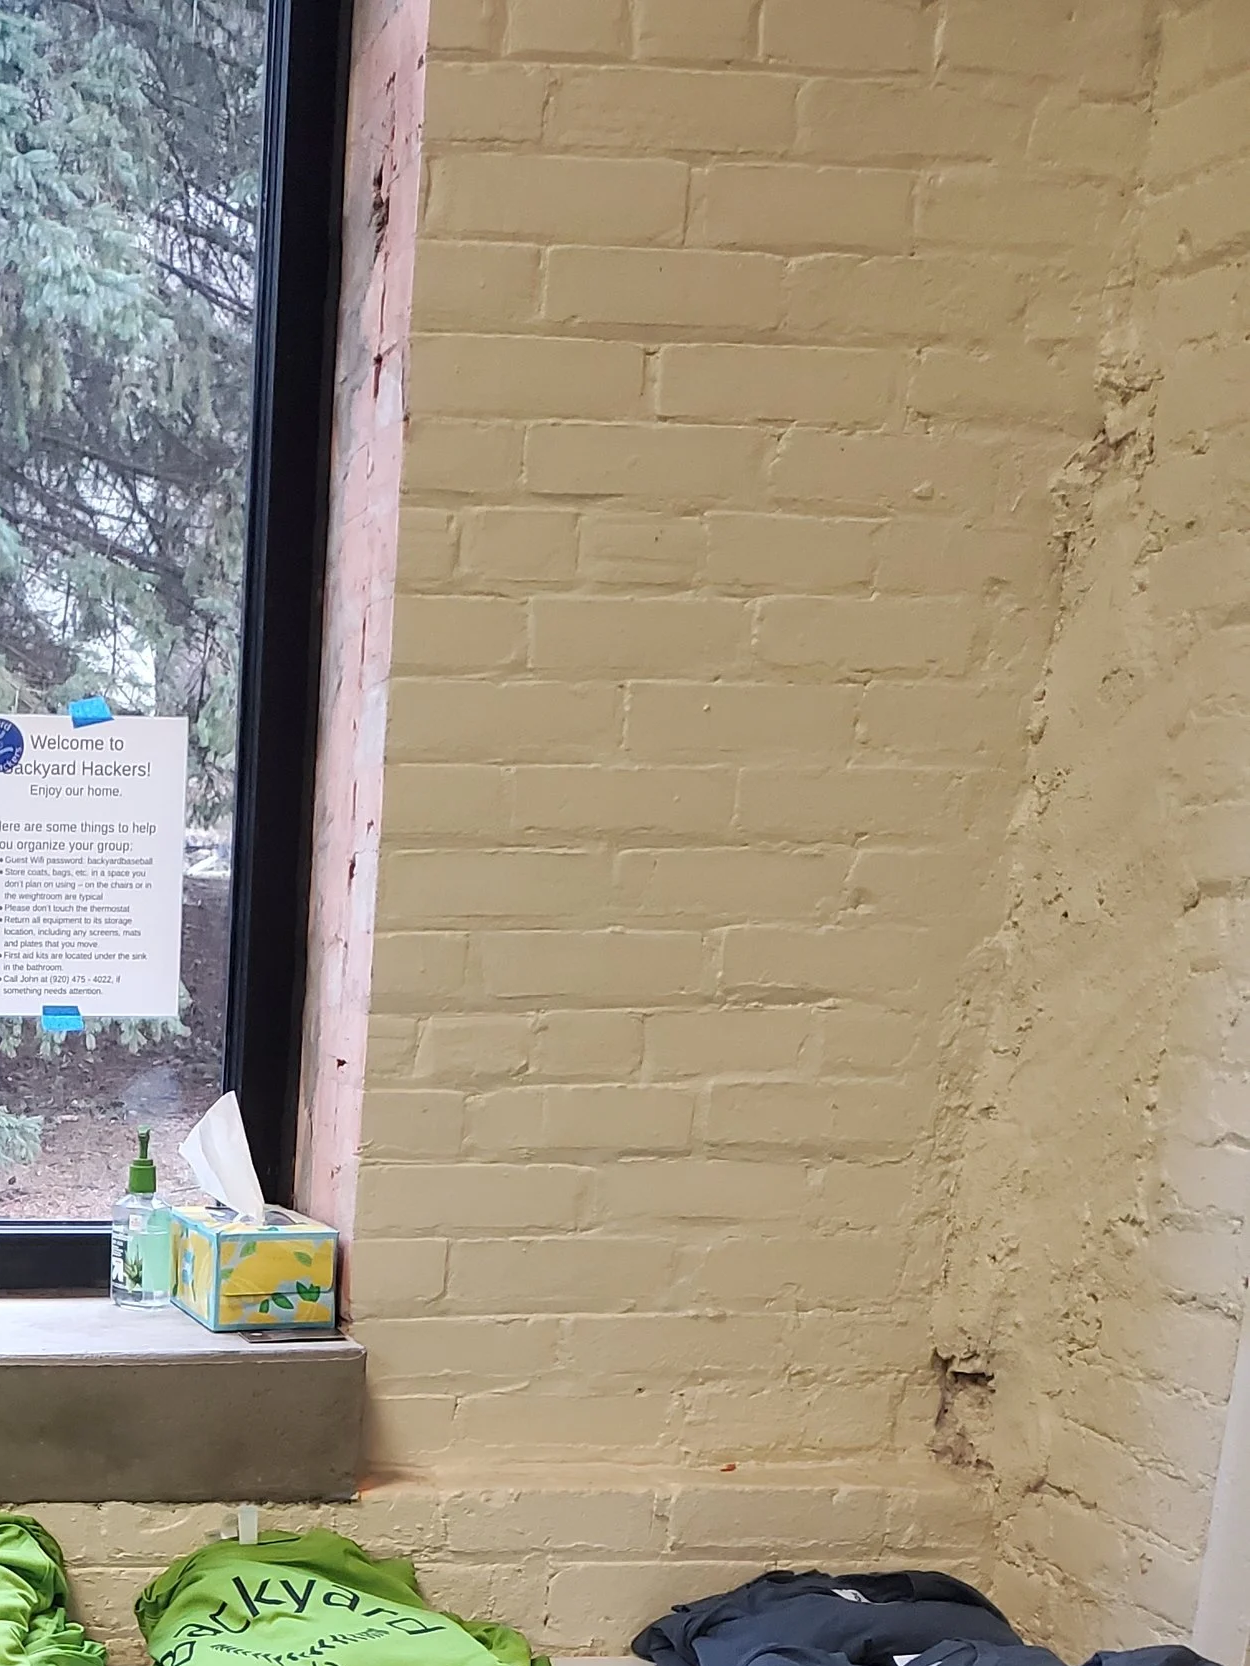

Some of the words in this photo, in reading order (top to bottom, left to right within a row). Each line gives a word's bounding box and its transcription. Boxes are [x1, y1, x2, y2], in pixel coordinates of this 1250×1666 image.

[31, 735, 104, 751] Welcome
[110, 737, 124, 751] to
[3, 761, 76, 778] ackyard
[82, 761, 151, 777] Hackers!
[30, 784, 62, 799] Enjoy
[65, 787, 83, 796] our
[88, 784, 122, 797] home.
[24, 823, 42, 832] are
[46, 823, 77, 832] some
[81, 821, 114, 836] things
[118, 823, 129, 833] to
[132, 822, 157, 836] help
[17, 838, 65, 852] organize
[69, 842, 93, 853] your
[5, 856, 28, 864] Guest
[47, 855, 83, 866] password:
[87, 855, 153, 867] backyardbaseball
[5, 867, 25, 876] Store
[28, 867, 50, 877] coats,
[53, 867, 74, 878] bags,
[91, 869, 98, 877] in
[108, 869, 130, 878] space
[5, 880, 23, 888] don't
[26, 879, 42, 890] plan
[55, 881, 76, 890] using
[97, 879, 108, 888] the
[111, 879, 133, 889] chairs
[4, 891, 16, 900] the
[4, 904, 30, 912] Please
[33, 904, 51, 912] don't
[53, 904, 74, 912] touch
[4, 915, 30, 924] Return
[32, 916, 40, 924] all
[43, 915, 82, 927] equipment
[94, 916, 102, 924] its
[104, 917, 132, 926] storage
[4, 927, 35, 936] location,
[38, 927, 71, 938] including
[73, 930, 87, 938] any
[20, 940, 43, 949] plates
[45, 940, 59, 948] that
[61, 941, 75, 950] you
[4, 951, 20, 959] First
[22, 951, 34, 959] aid
[36, 951, 49, 959] kits
[65, 952, 92, 960] located
[95, 951, 116, 960] under
[4, 963, 10, 971] in
[26, 963, 63, 971] bathroom.
[20, 975, 38, 983] John
[50, 975, 69, 985] (920)
[72, 975, 86, 983] 475
[3, 987, 42, 996] something
[69, 987, 102, 995] attention.
